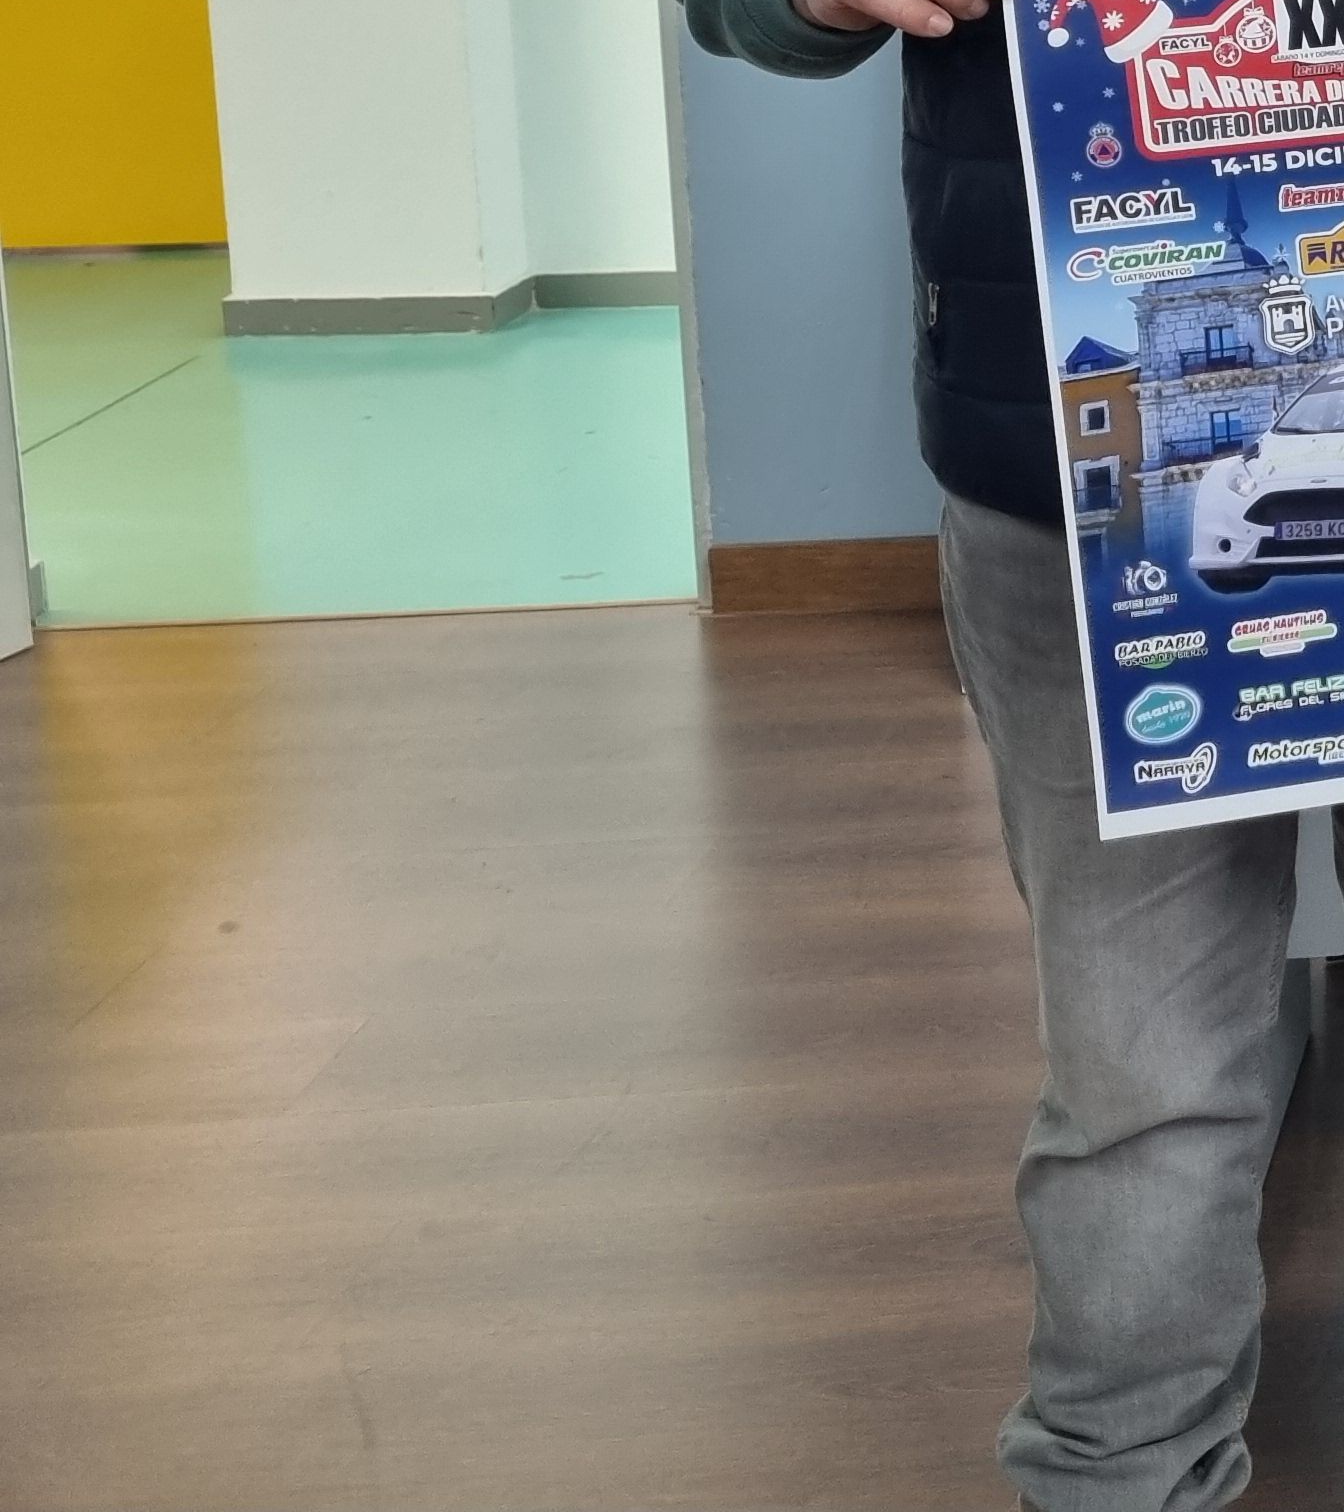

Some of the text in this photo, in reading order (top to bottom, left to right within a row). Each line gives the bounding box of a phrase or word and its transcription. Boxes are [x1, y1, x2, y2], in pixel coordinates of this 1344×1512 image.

[1161, 36, 1210, 51] FACYL
[1146, 59, 1322, 110] CARRERA
[1156, 114, 1251, 145] TROFEO
[1212, 153, 1277, 177] 14-15
[1072, 190, 1191, 224] FACYL
[1109, 244, 1223, 271] COVIRAN
[1114, 267, 1192, 284] CUATROVIENTOS
[1118, 643, 1150, 658] BAR
[1239, 685, 1284, 703] BAR
[1240, 694, 1324, 716] FLORES DEL
